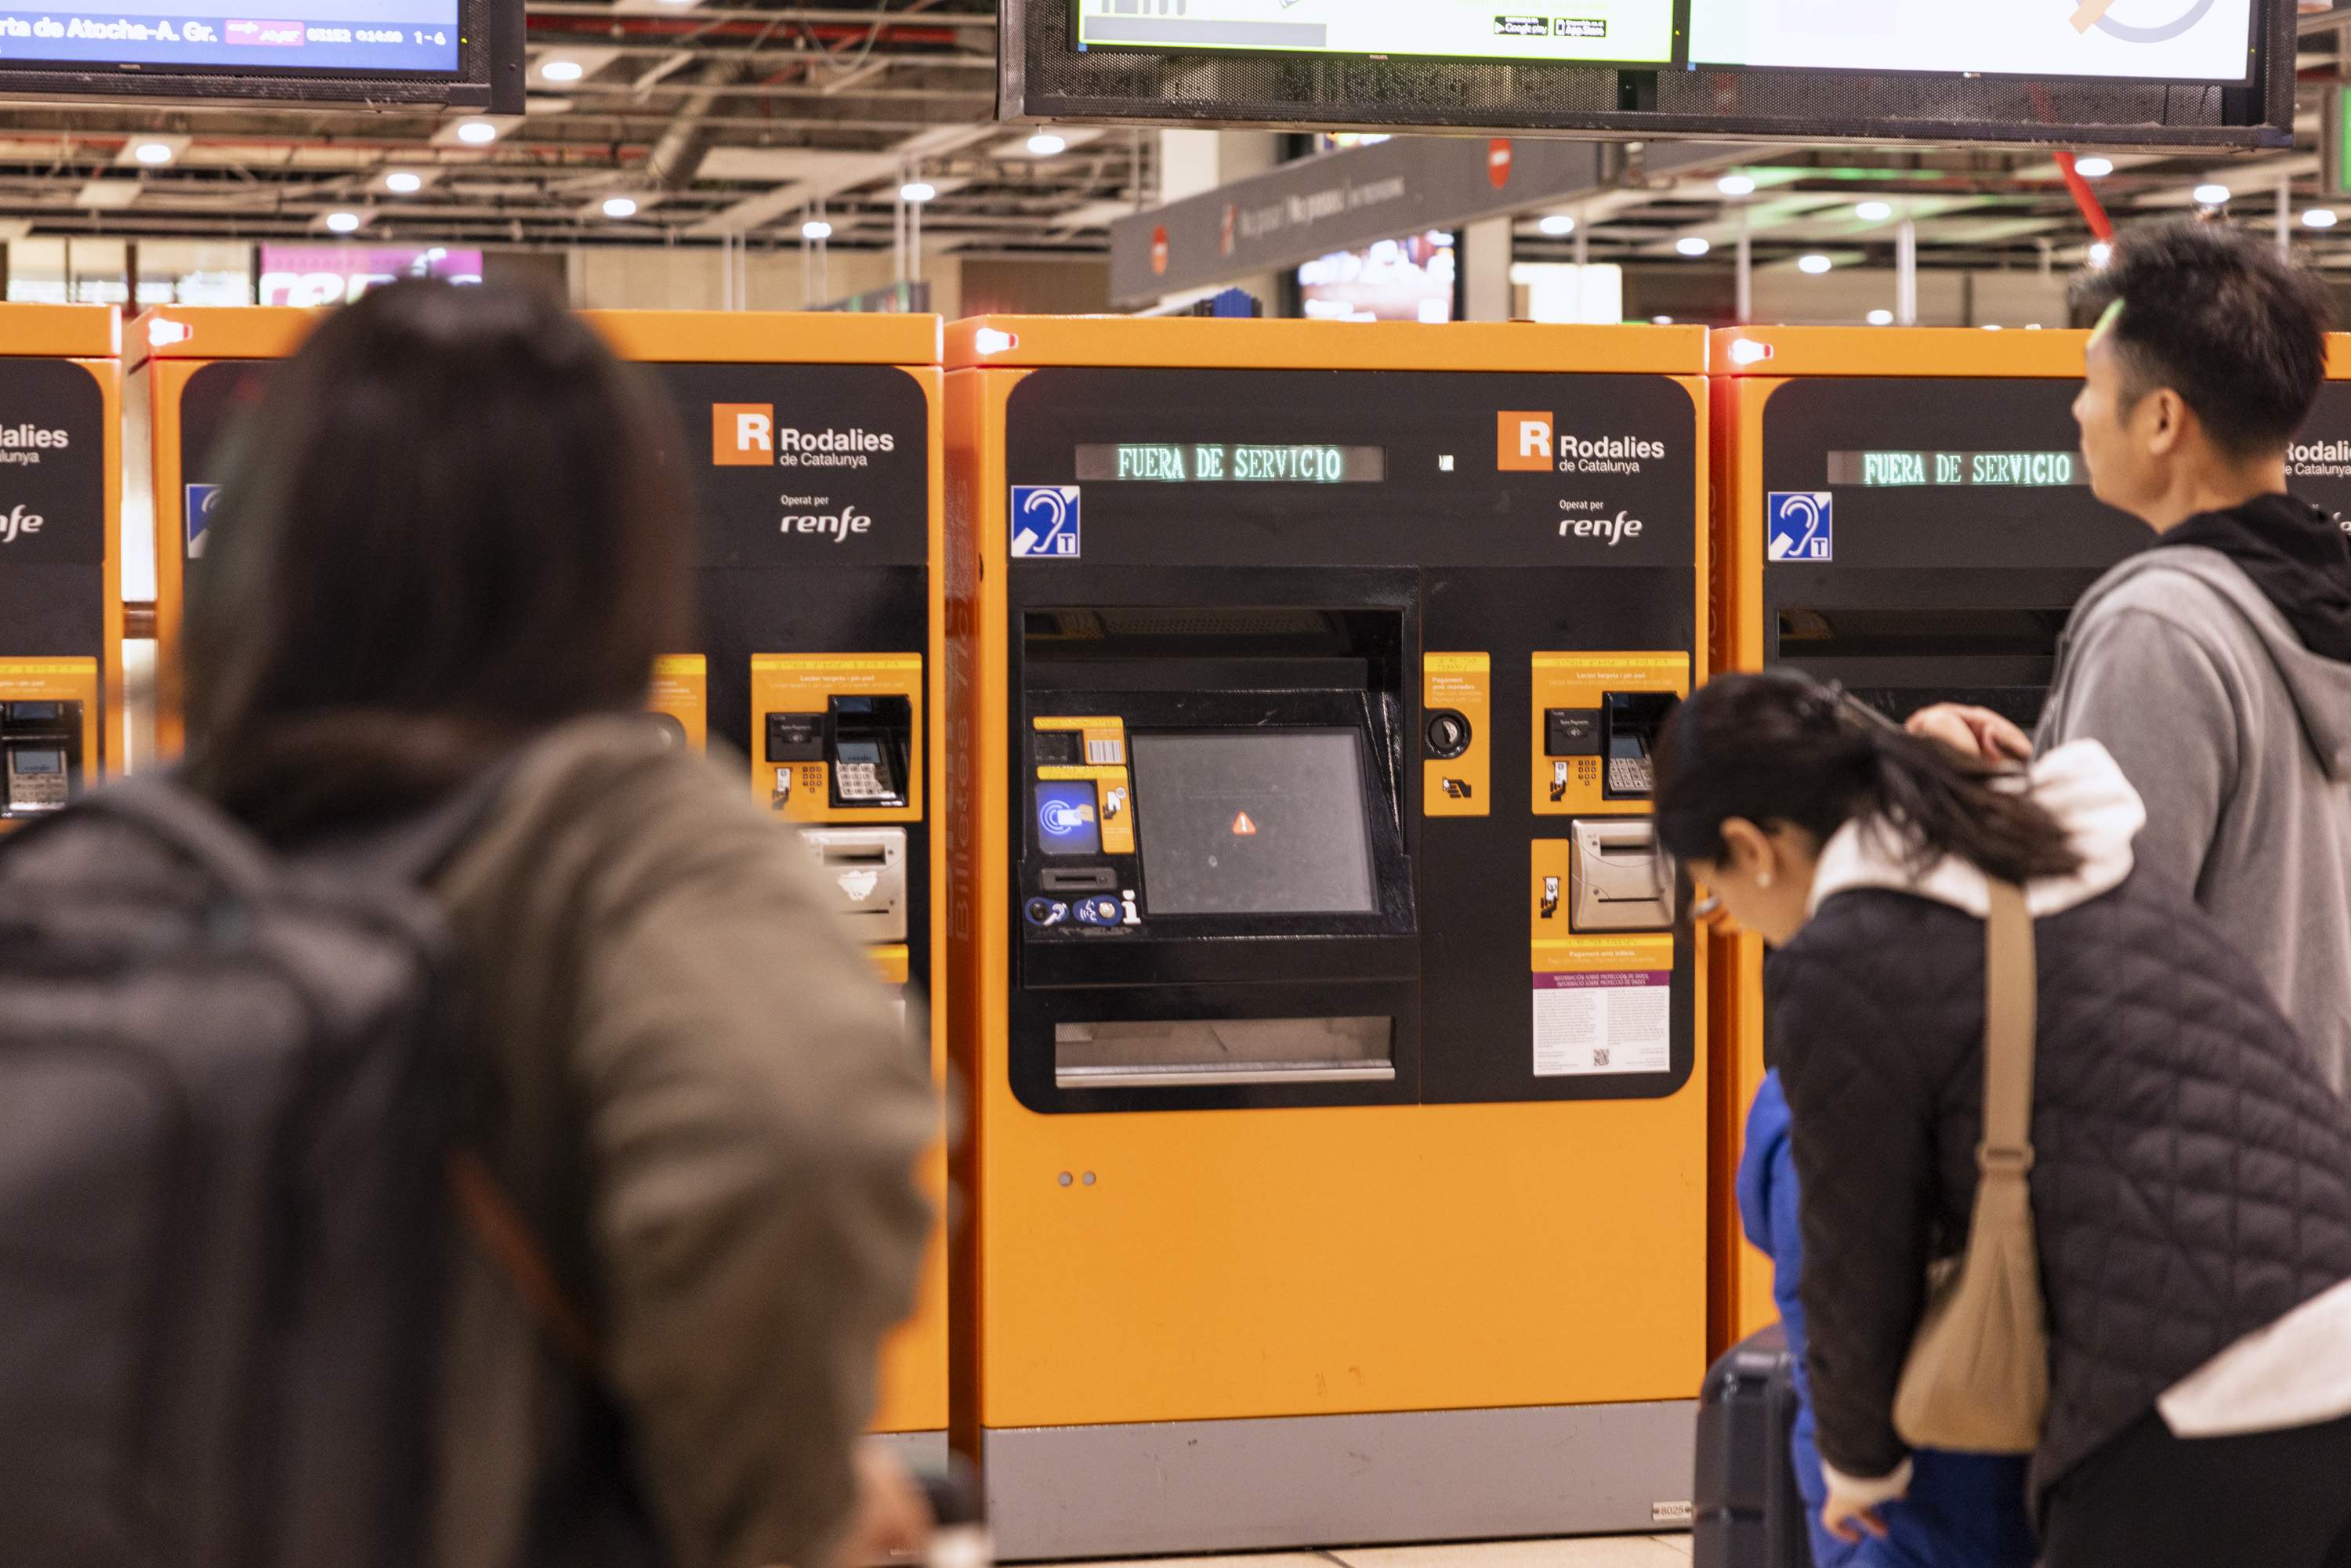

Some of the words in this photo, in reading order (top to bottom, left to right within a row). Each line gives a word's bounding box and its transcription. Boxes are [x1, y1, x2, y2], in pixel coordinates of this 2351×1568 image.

[33, 16, 65, 38] de
[182, 20, 218, 42] Gr.
[0, 424, 69, 448] alies
[737, 413, 771, 451] R
[781, 428, 895, 451] Rodalies
[1519, 420, 1551, 457] R
[0, 449, 40, 465] lunya
[1560, 435, 1665, 459] Rodalies
[780, 453, 799, 466] de
[801, 453, 868, 469] Catalunya
[1118, 447, 1185, 478] FUERA
[1196, 447, 1223, 478] DE
[1234, 447, 1341, 480] SERVICIO
[1559, 459, 1575, 472] de
[1578, 459, 1640, 475] Catalunya
[1863, 454, 1925, 484] FUERA
[1936, 454, 1962, 483] DE
[1972, 454, 2070, 483] SERVICIO
[781, 494, 812, 506] Operat
[814, 496, 830, 506] per
[1559, 499, 1588, 512] Operat
[1590, 501, 1604, 512] per
[780, 505, 871, 542] renfe
[1559, 510, 1643, 546] renfe
